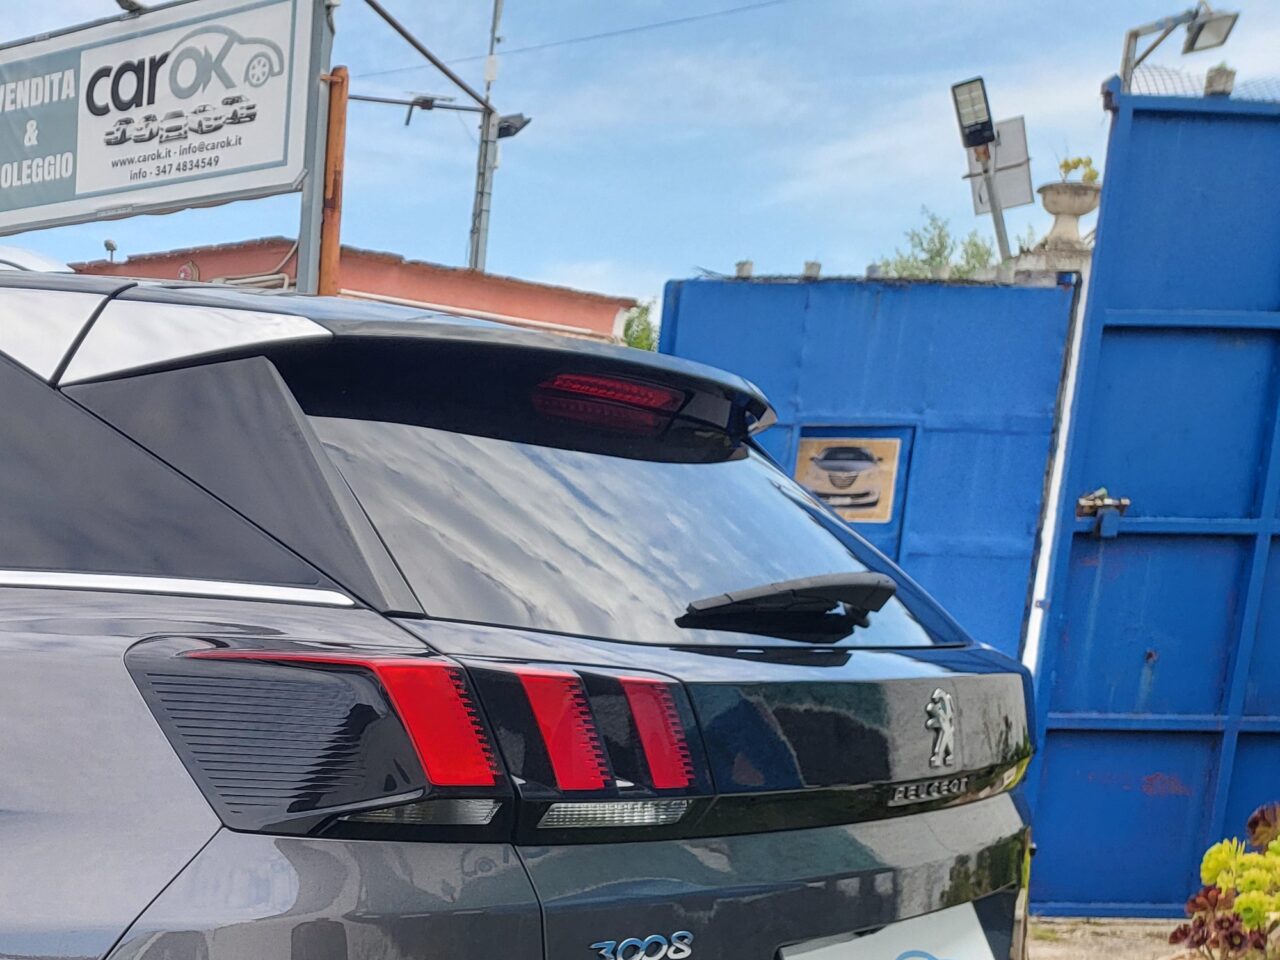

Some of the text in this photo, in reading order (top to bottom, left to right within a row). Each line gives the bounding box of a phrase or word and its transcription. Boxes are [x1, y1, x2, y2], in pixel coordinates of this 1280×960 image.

[23, 119, 38, 146] &
[111, 147, 172, 168] www.carok.it
[178, 135, 242, 156] info@carok.it
[129, 168, 147, 181] info
[155, 163, 173, 176] 347
[175, 155, 220, 172] 4834549
